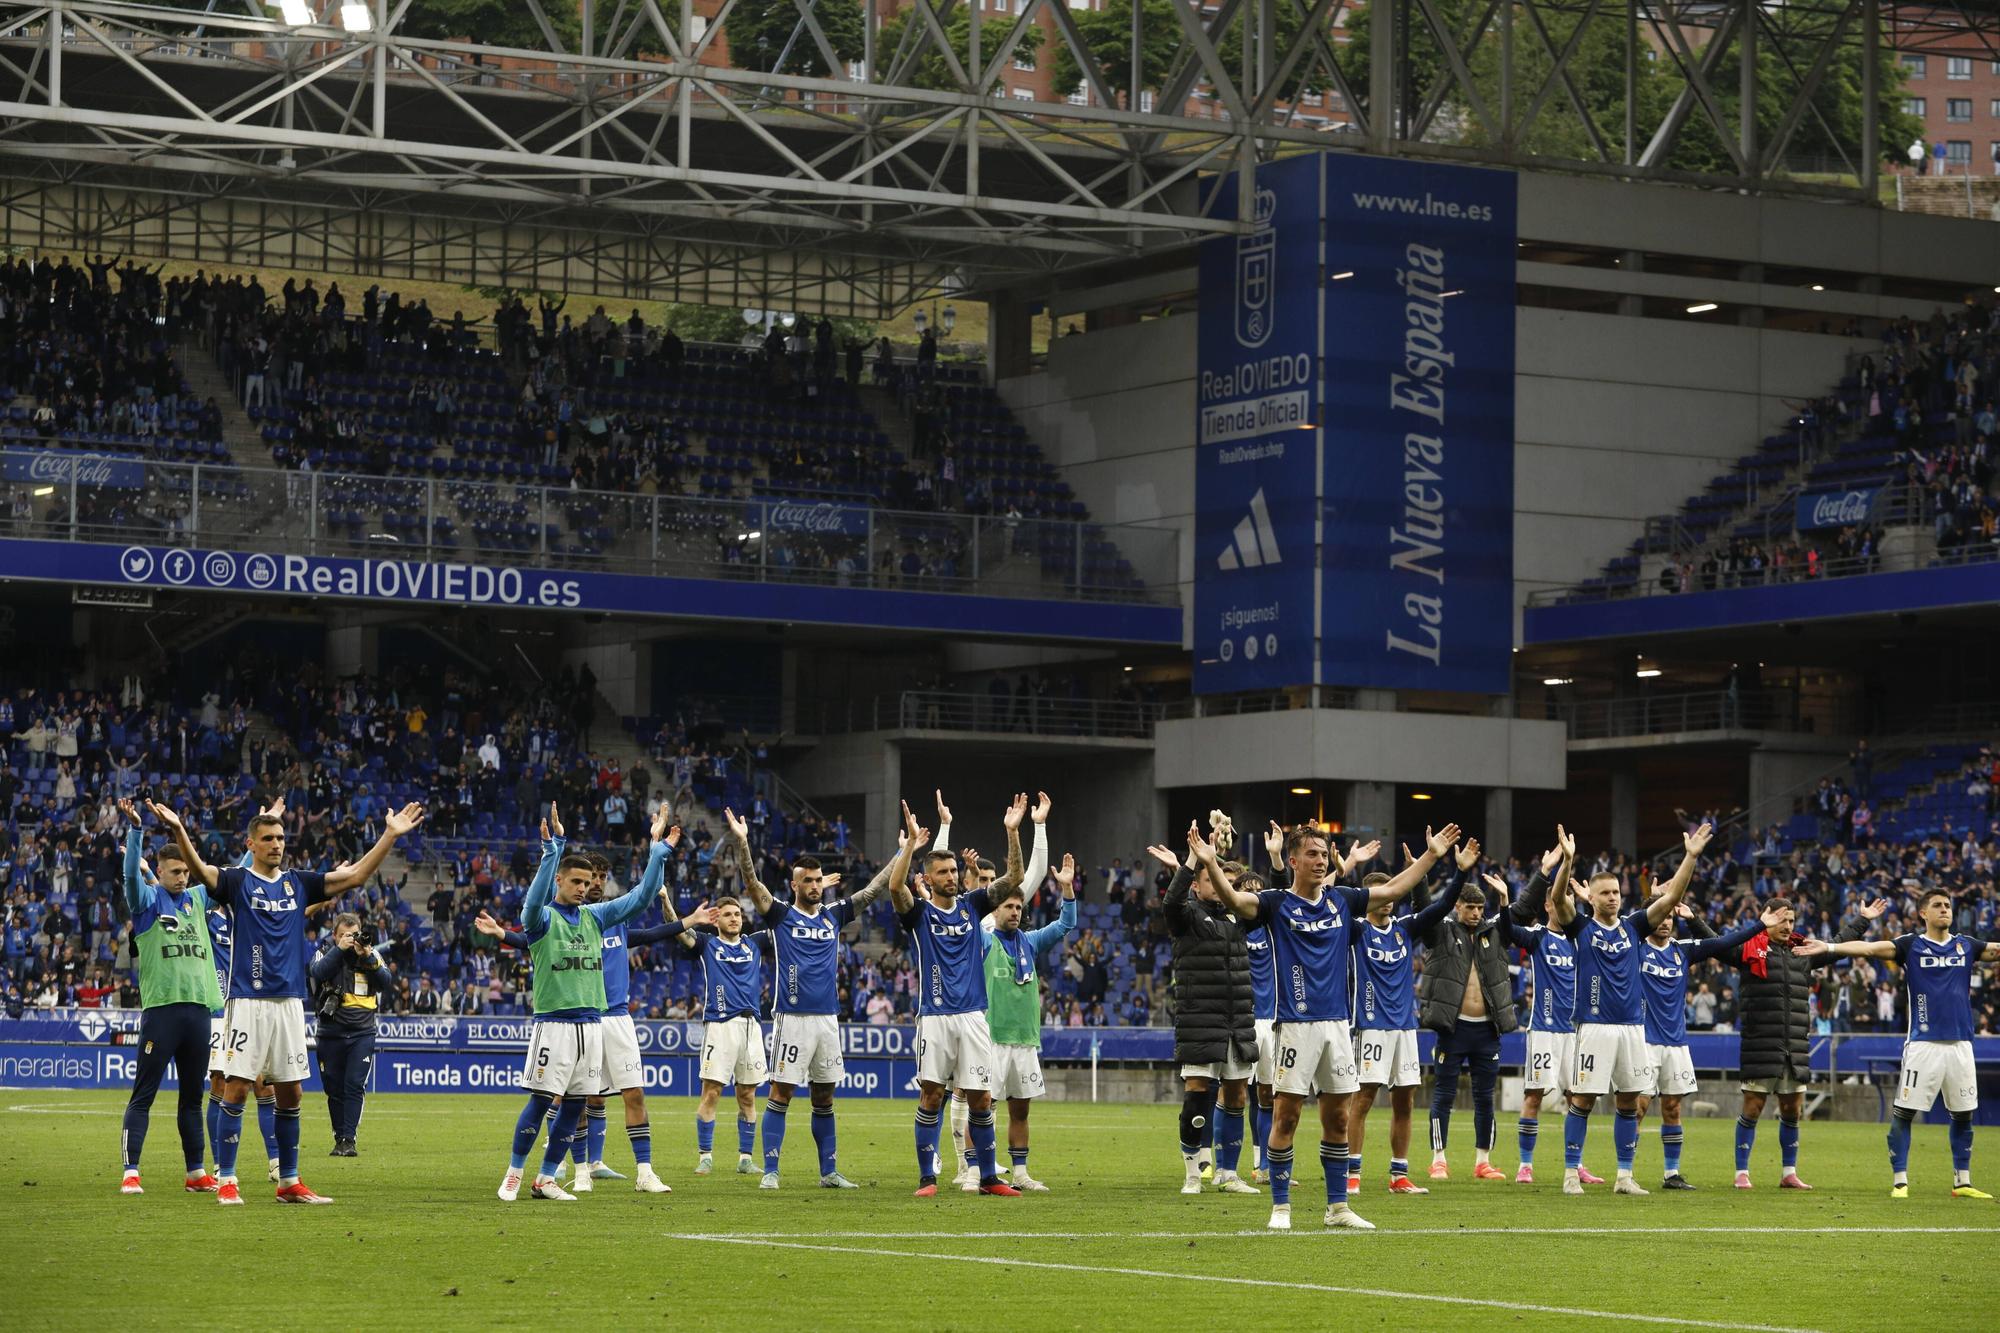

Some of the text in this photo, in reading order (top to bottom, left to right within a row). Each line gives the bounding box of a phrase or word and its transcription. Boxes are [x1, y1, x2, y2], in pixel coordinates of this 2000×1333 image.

[1352, 191, 1493, 222] www.lne.es
[1202, 353, 1311, 400] RealOVIEDO
[1204, 394, 1306, 437] Tienda Oficial
[1387, 242, 1455, 667] La Nueva España
[284, 554, 581, 606] RealOVIEDO.es
[251, 897, 298, 913] DIGI
[791, 927, 836, 940] DIGI
[1290, 914, 1343, 932] DIGI
[1368, 946, 1408, 963] DIGI
[1591, 936, 1632, 953] DIGI
[252, 945, 260, 979] OVIEDO
[1642, 961, 1683, 977] DIGI
[1920, 956, 1966, 968] DIGI
[932, 964, 940, 996] OVIEDO
[1292, 965, 1302, 1001] OVIEDO
[1365, 981, 1373, 1011] OVIEDO
[1543, 988, 1551, 1017] OVIEDO
[230, 1028, 248, 1052] 12
[467, 1024, 482, 1039] EL
[538, 1047, 550, 1067] 5
[706, 1044, 715, 1061] 7
[780, 1043, 799, 1064] 19
[1279, 1046, 1297, 1069] 18
[1533, 1052, 1551, 1070] 22
[1580, 1053, 1595, 1072] 14
[393, 1063, 461, 1086] Tienda
[1905, 1069, 1918, 1088] 11
